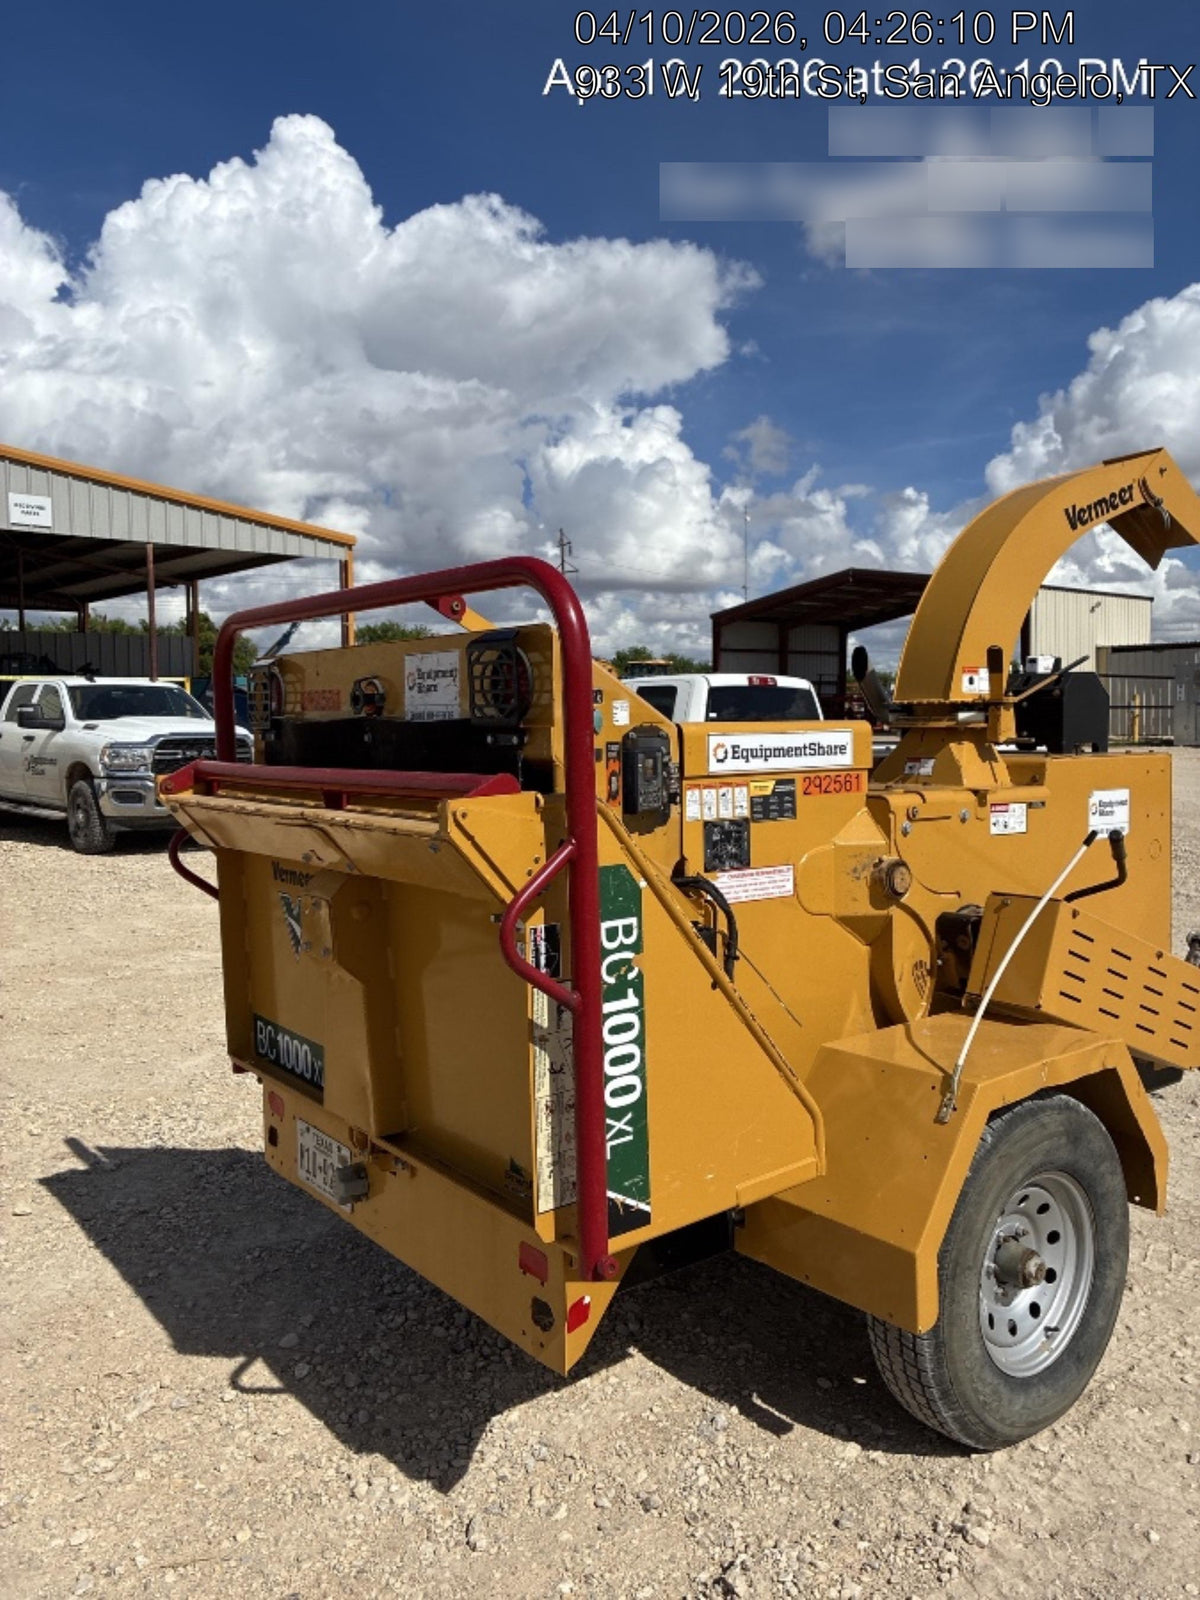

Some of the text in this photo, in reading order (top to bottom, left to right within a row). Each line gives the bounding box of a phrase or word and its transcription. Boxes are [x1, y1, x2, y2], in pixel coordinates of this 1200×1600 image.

[1064, 483, 1134, 531] Vermeer
[730, 741, 848, 763] EquipmentShare
[802, 773, 861, 796] 292561
[271, 860, 315, 888] Verme
[256, 1019, 277, 1060] BC
[276, 1033, 312, 1079] 1000
[600, 917, 643, 1161] BC 1000 XL
